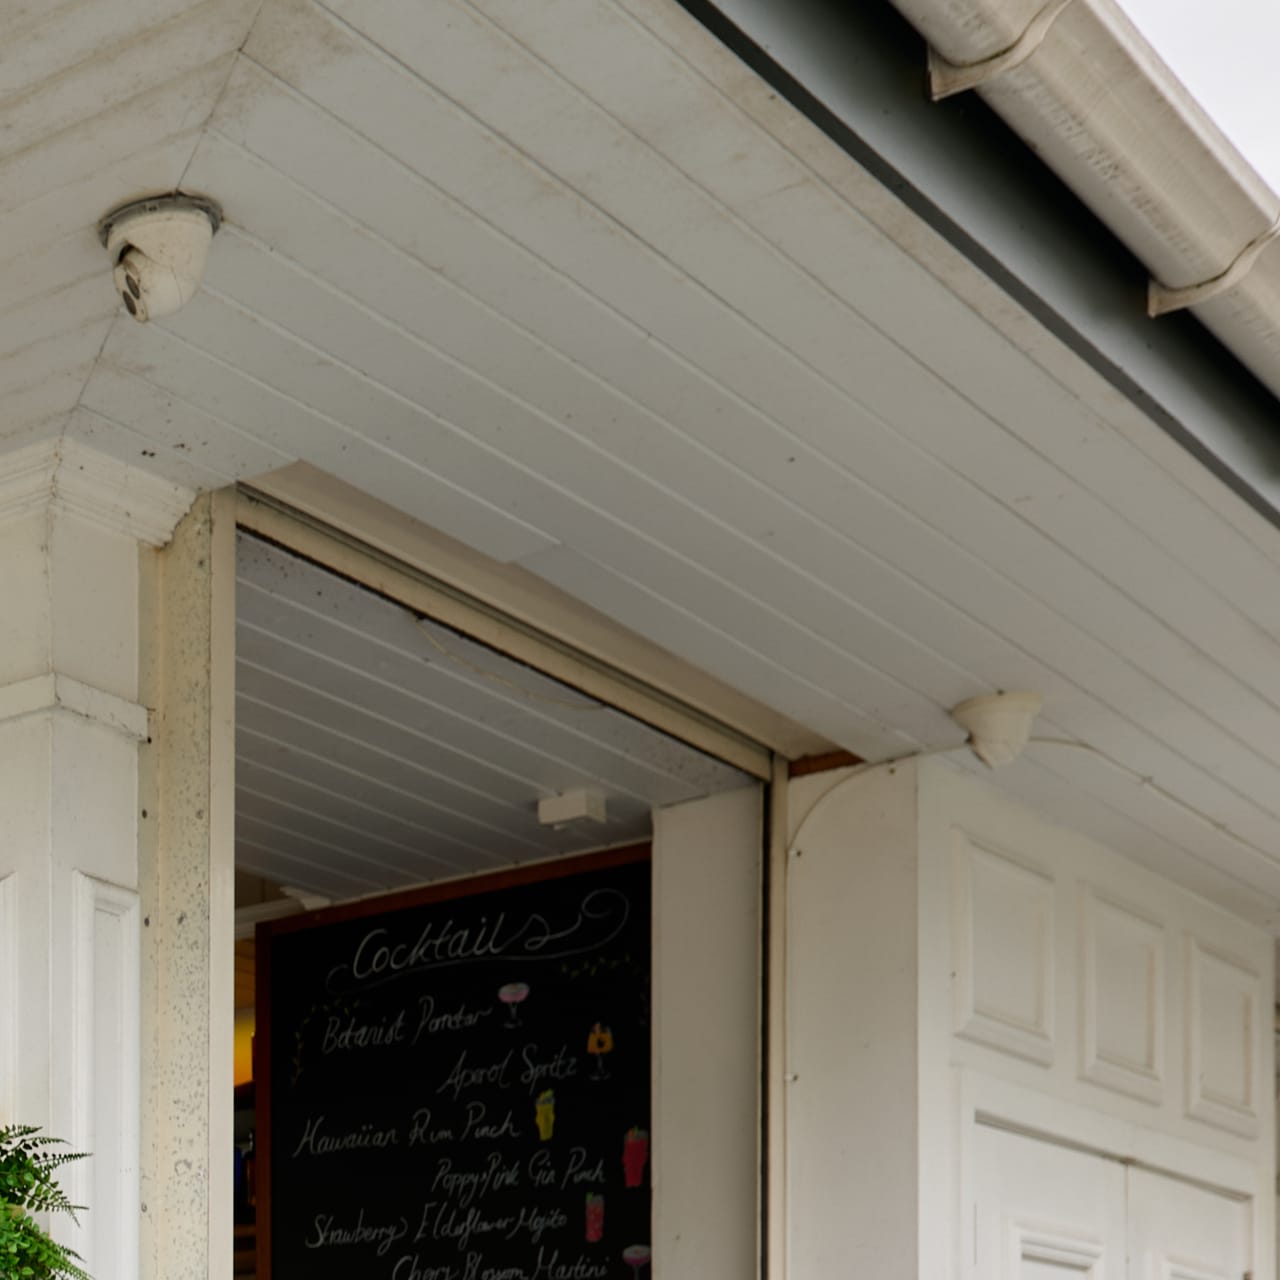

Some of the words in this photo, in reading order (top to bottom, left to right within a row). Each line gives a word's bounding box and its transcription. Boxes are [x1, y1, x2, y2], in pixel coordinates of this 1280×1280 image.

[351, 911, 583, 980] Cocktails
[320, 1008, 407, 1056] Botanist
[434, 1048, 515, 1102] Aperol
[519, 1041, 578, 1095] Spritz
[291, 1113, 400, 1159] Hawaiian
[408, 1106, 454, 1148] Rum
[460, 1100, 522, 1143] Punch
[527, 1147, 557, 1188] Gin
[559, 1145, 607, 1192] Punch
[304, 1207, 409, 1258] Strawberry
[413, 1200, 516, 1253] Elderflower
